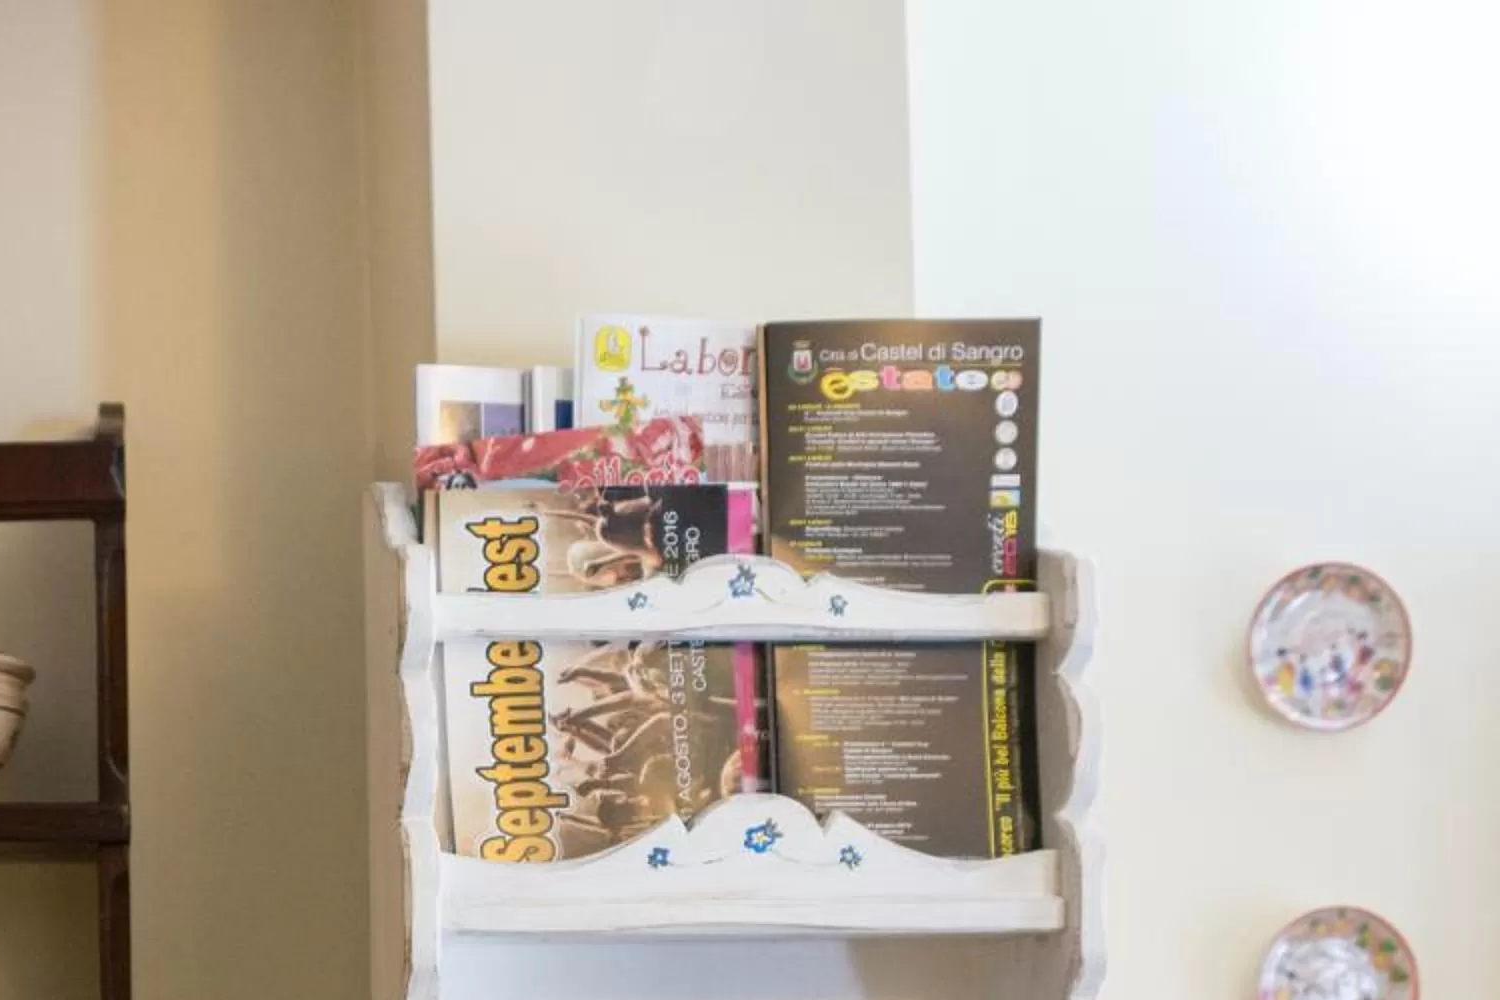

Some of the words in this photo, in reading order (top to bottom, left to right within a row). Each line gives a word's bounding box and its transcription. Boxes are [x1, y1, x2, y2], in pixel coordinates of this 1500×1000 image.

[860, 342, 923, 361] Castel
[927, 342, 948, 360] di
[951, 342, 1025, 365] Sangro
[663, 511, 679, 559] 2016
